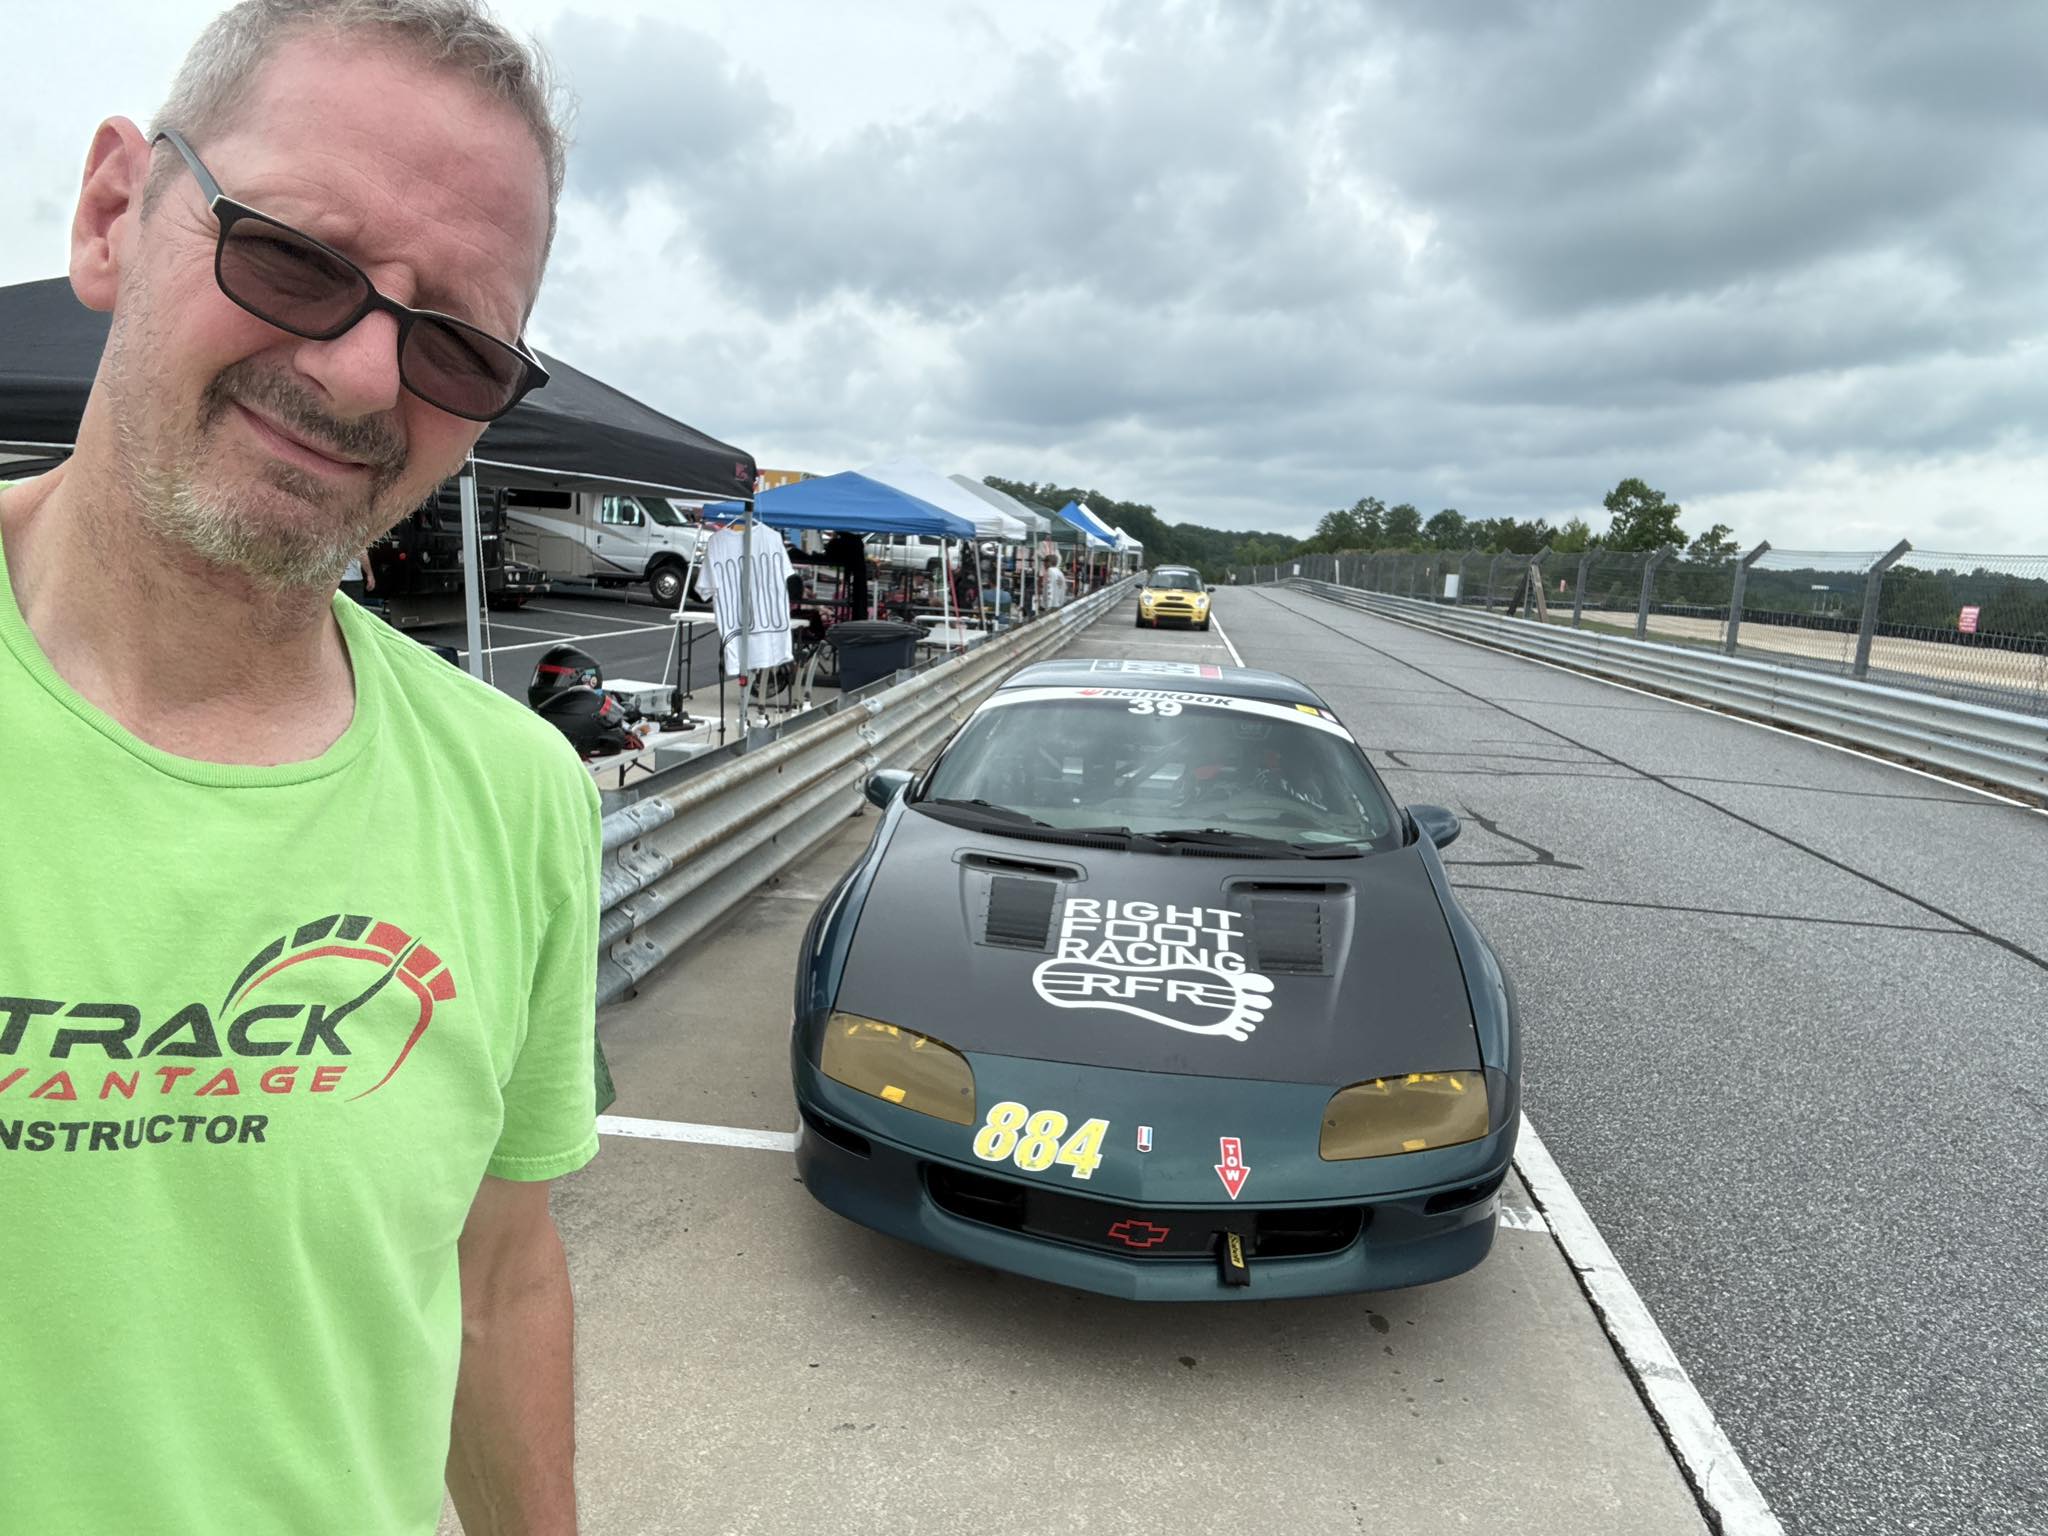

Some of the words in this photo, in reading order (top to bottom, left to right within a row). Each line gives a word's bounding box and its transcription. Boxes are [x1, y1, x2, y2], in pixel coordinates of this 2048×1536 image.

[1128, 699, 1183, 717] 39
[1064, 898, 1242, 930] RIGHT
[1060, 917, 1244, 951] FOOT
[1057, 937, 1246, 975] RACING
[0, 997, 352, 1059] TRACK
[0, 1114, 268, 1152] NSTRUCTOR
[973, 1101, 1110, 1180] 884
[1225, 1144, 1240, 1181] TOW
